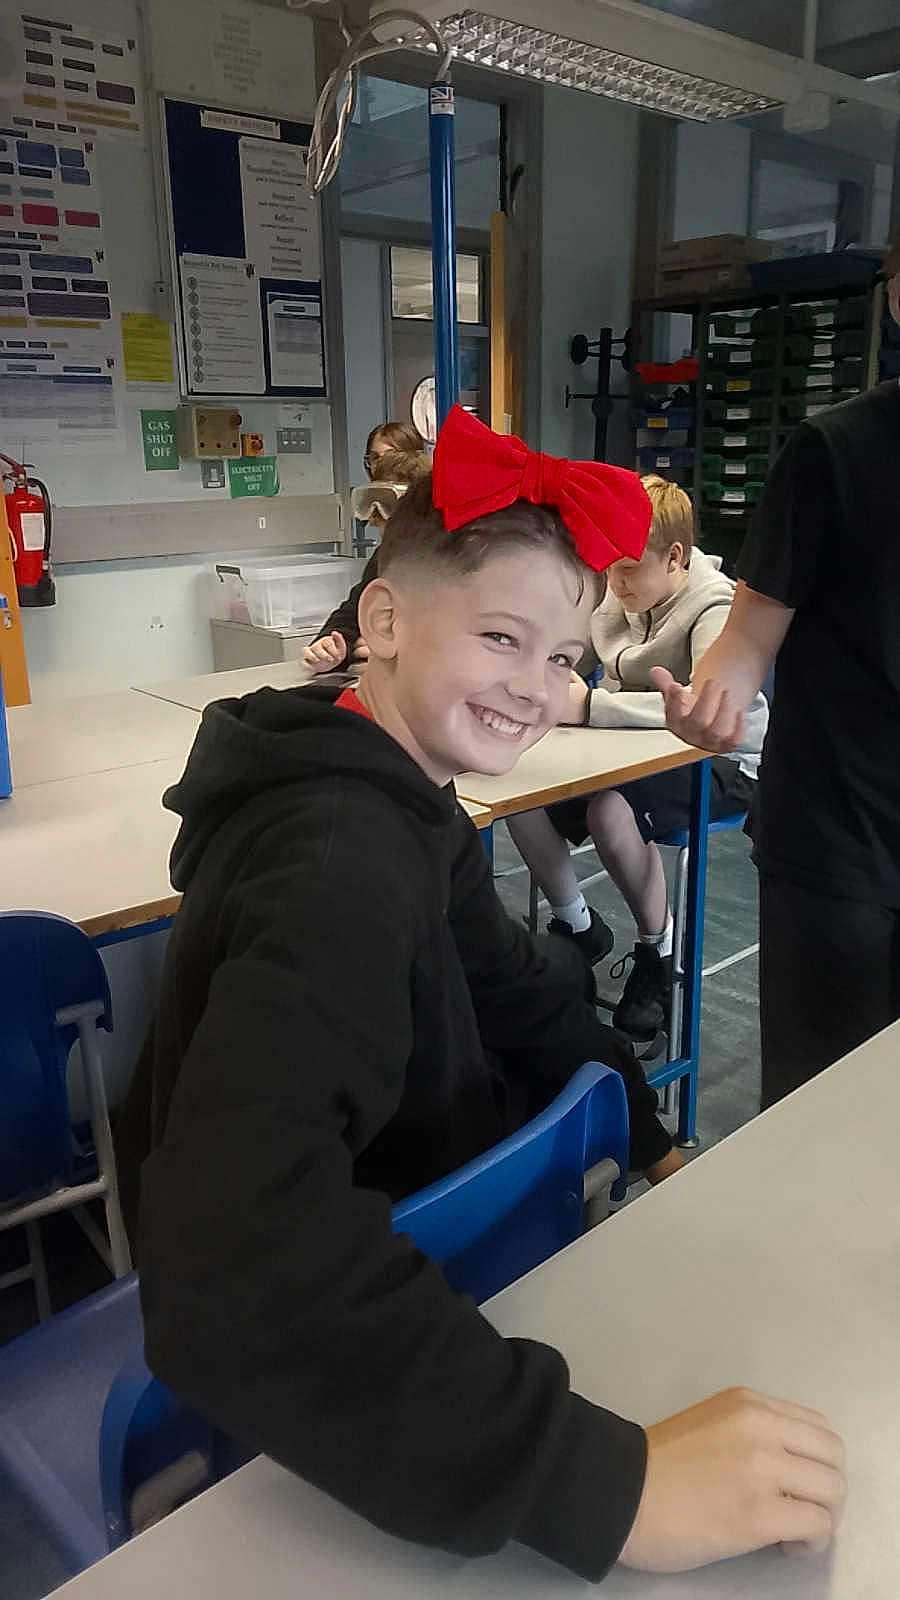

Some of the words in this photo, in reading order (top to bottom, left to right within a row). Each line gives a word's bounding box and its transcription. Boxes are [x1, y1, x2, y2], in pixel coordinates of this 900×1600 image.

[147, 420, 170, 431] GAS
[146, 434, 174, 444] SHUT
[152, 447, 171, 457] OFF
